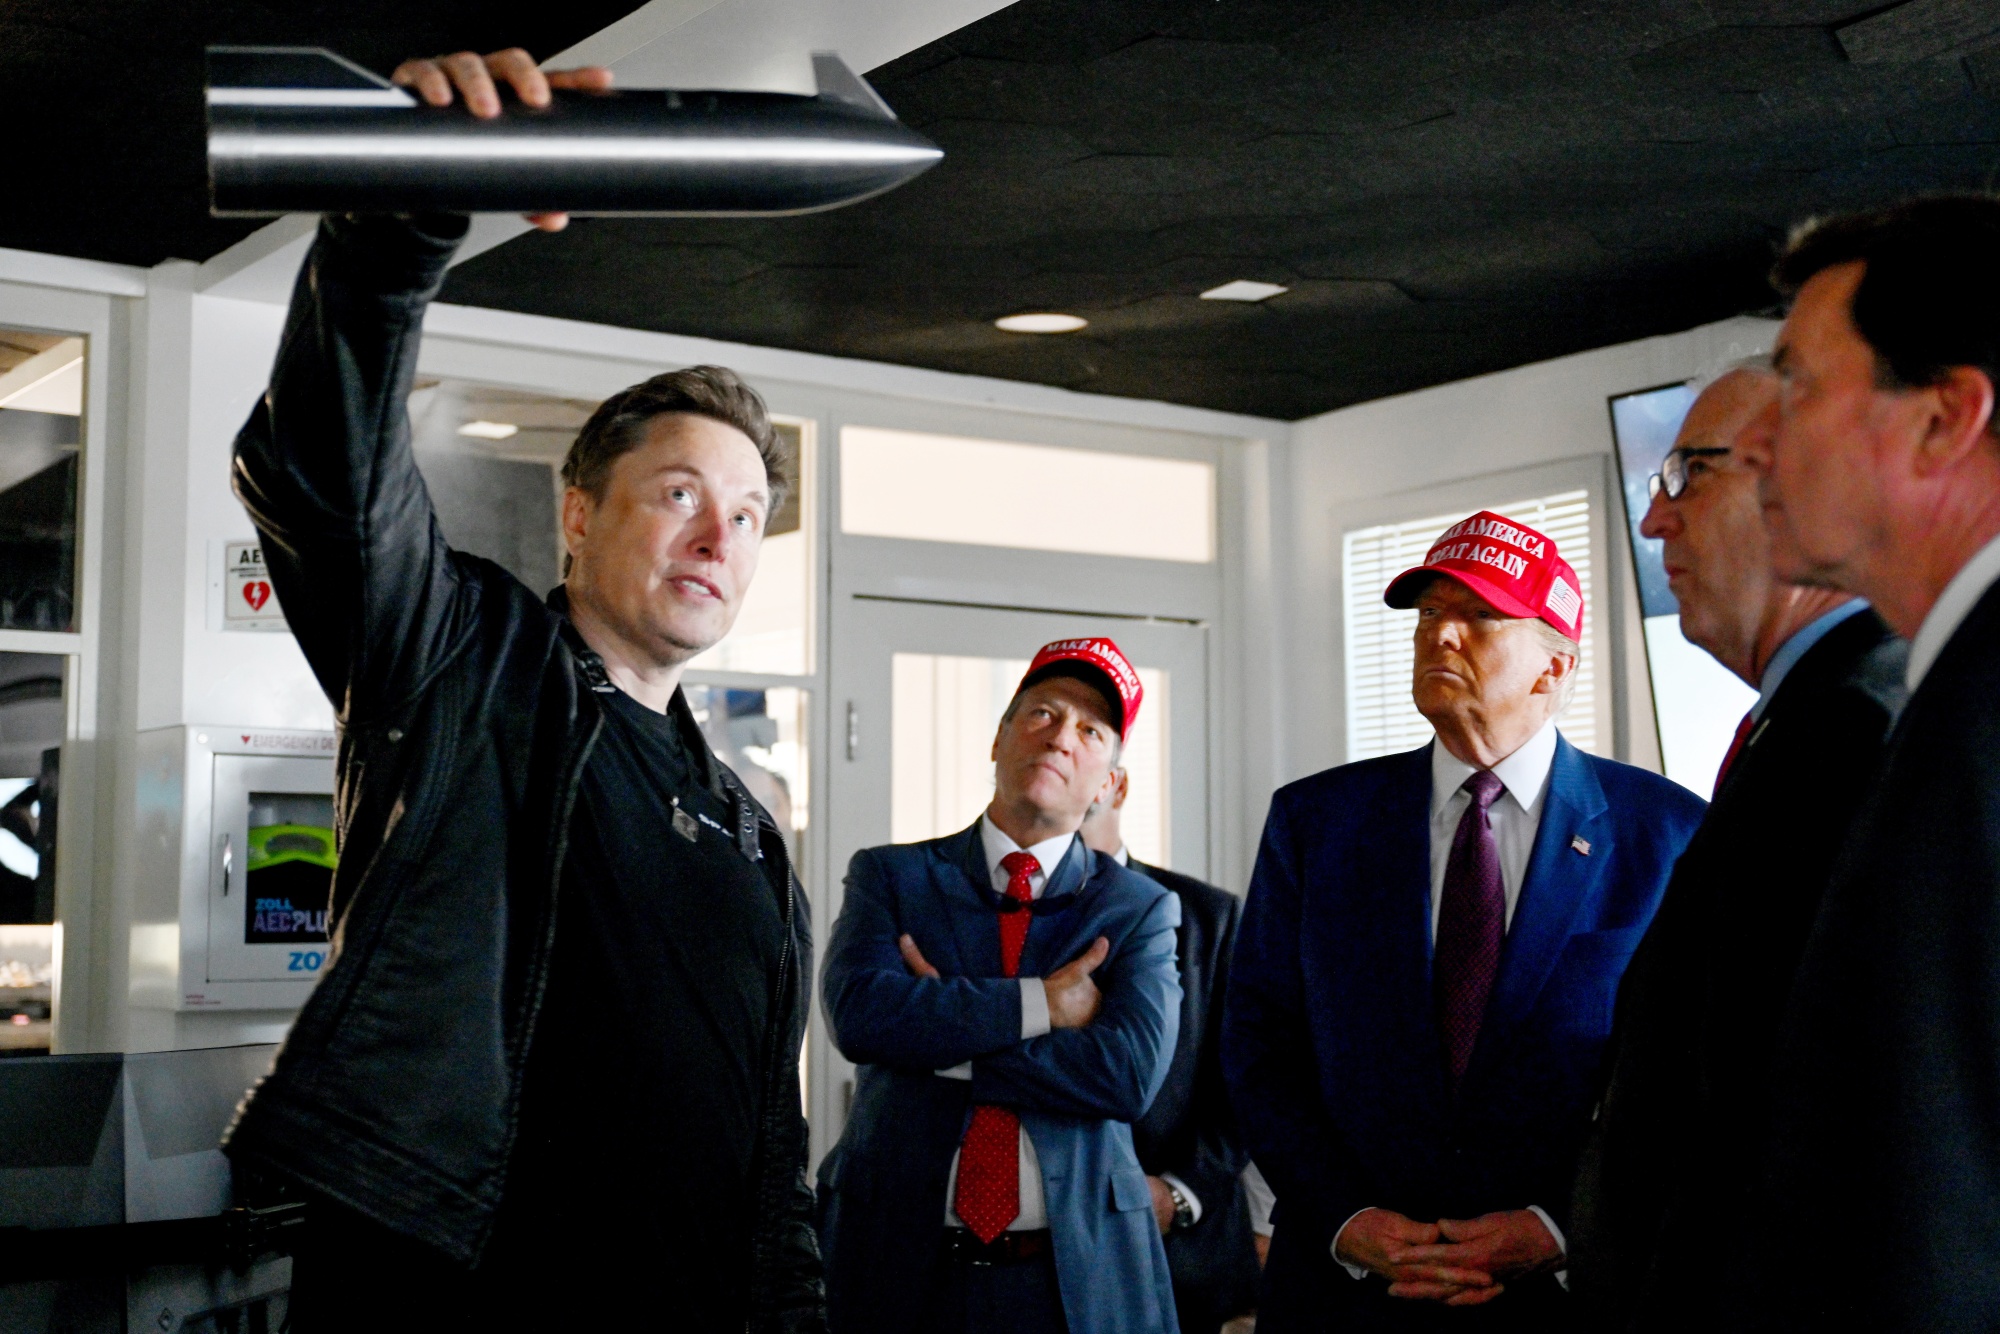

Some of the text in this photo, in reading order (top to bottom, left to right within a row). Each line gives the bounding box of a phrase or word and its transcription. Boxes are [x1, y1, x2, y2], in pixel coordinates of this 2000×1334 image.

[1463, 519, 1545, 559] AMERICA
[240, 549, 264, 563] AE
[1466, 543, 1529, 580] AGAIN
[1046, 640, 1091, 652] MAKE
[1089, 642, 1140, 700] AMERICA
[253, 734, 318, 750] EMERGENCY
[255, 897, 293, 910] ZOLL
